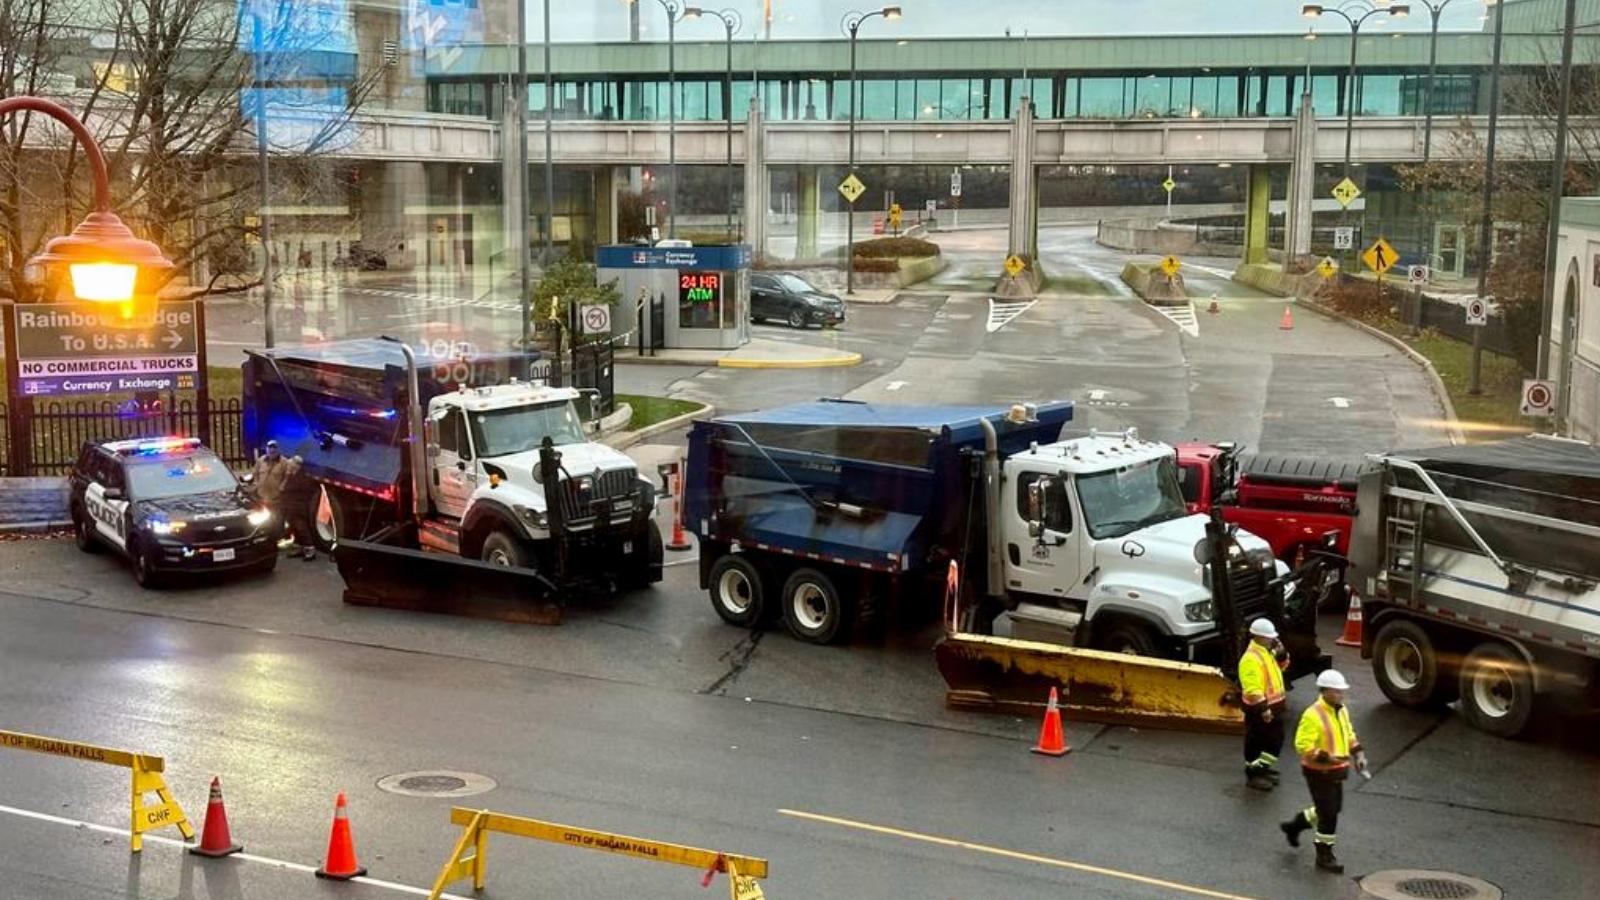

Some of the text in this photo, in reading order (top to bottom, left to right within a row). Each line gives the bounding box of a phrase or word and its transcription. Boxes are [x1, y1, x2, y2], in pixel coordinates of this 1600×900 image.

[1338, 235, 1350, 245] 15
[681, 275, 719, 289] 24 HR
[687, 288, 714, 301] ATM
[20, 311, 109, 328] Rainbo
[60, 332, 155, 351] To U.S.A.
[23, 357, 194, 374] NO COMMERCIAL TRUCKS
[63, 380, 112, 391] Currency
[119, 377, 171, 391] Exchange
[1302, 493, 1350, 504] Tornado
[87, 497, 117, 528] POLICE
[73, 745, 105, 761] FALLS
[147, 808, 171, 824] CNF
[564, 832, 581, 843] CITY
[583, 835, 594, 845] OF
[632, 843, 659, 857] FALLS
[737, 879, 756, 895] CNF
